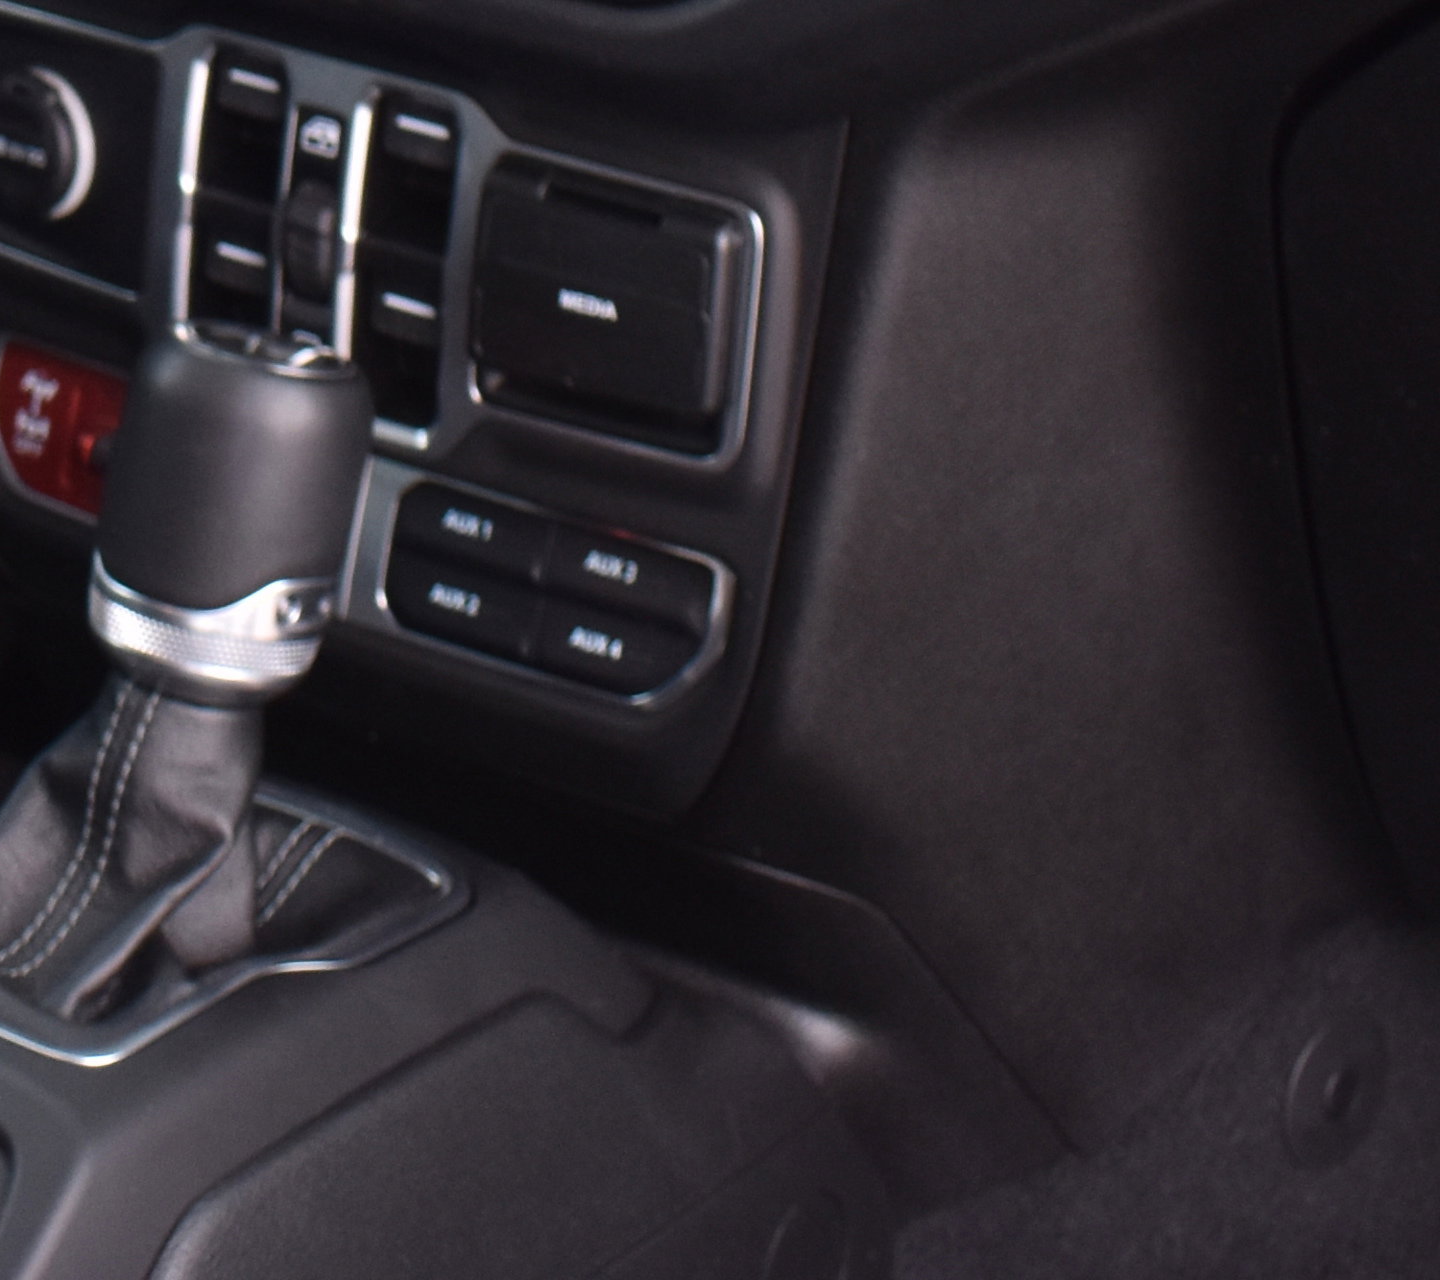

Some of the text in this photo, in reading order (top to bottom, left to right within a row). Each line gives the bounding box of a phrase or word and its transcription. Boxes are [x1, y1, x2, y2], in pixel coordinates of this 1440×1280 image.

[558, 288, 618, 322] MEDIA
[441, 507, 480, 538] AUX
[583, 549, 623, 580] AUX
[428, 582, 467, 613] AUX
[569, 625, 609, 656] AUX
